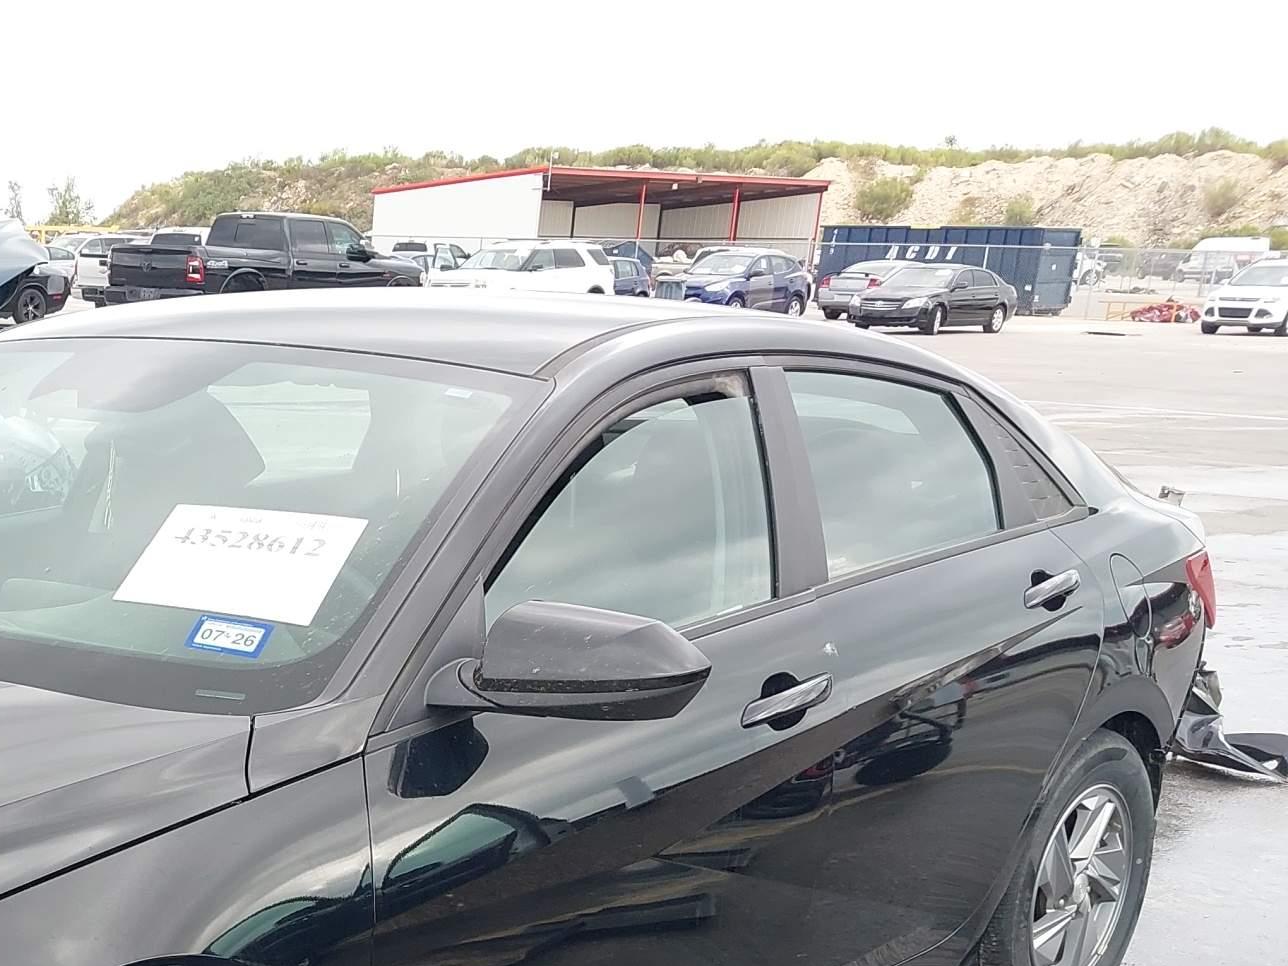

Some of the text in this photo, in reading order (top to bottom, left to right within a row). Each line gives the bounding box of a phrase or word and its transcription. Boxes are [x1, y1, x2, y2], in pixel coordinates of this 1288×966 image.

[174, 527, 326, 556] 43528612
[201, 628, 257, 647] 07 26
